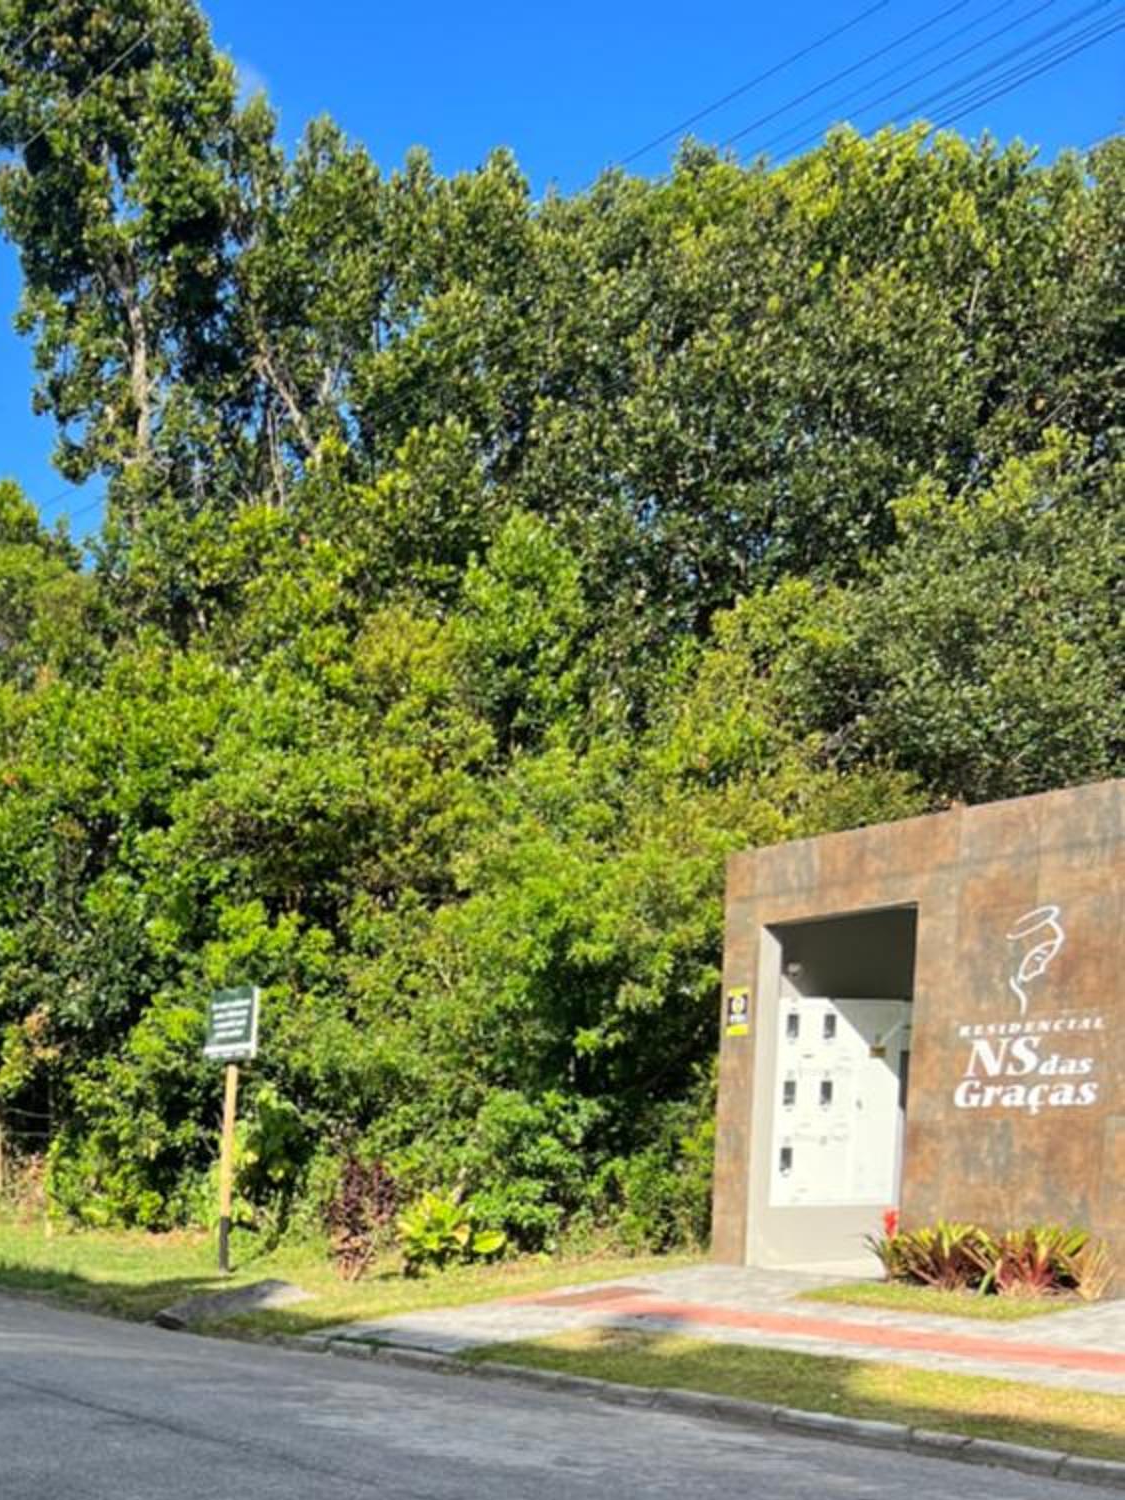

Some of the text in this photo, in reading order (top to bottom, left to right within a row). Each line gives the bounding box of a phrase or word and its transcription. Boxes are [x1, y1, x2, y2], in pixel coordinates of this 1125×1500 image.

[958, 1017, 1105, 1038] RESIDENCIAL
[963, 1035, 1093, 1077] NS das
[954, 1079, 1098, 1116] Graças
